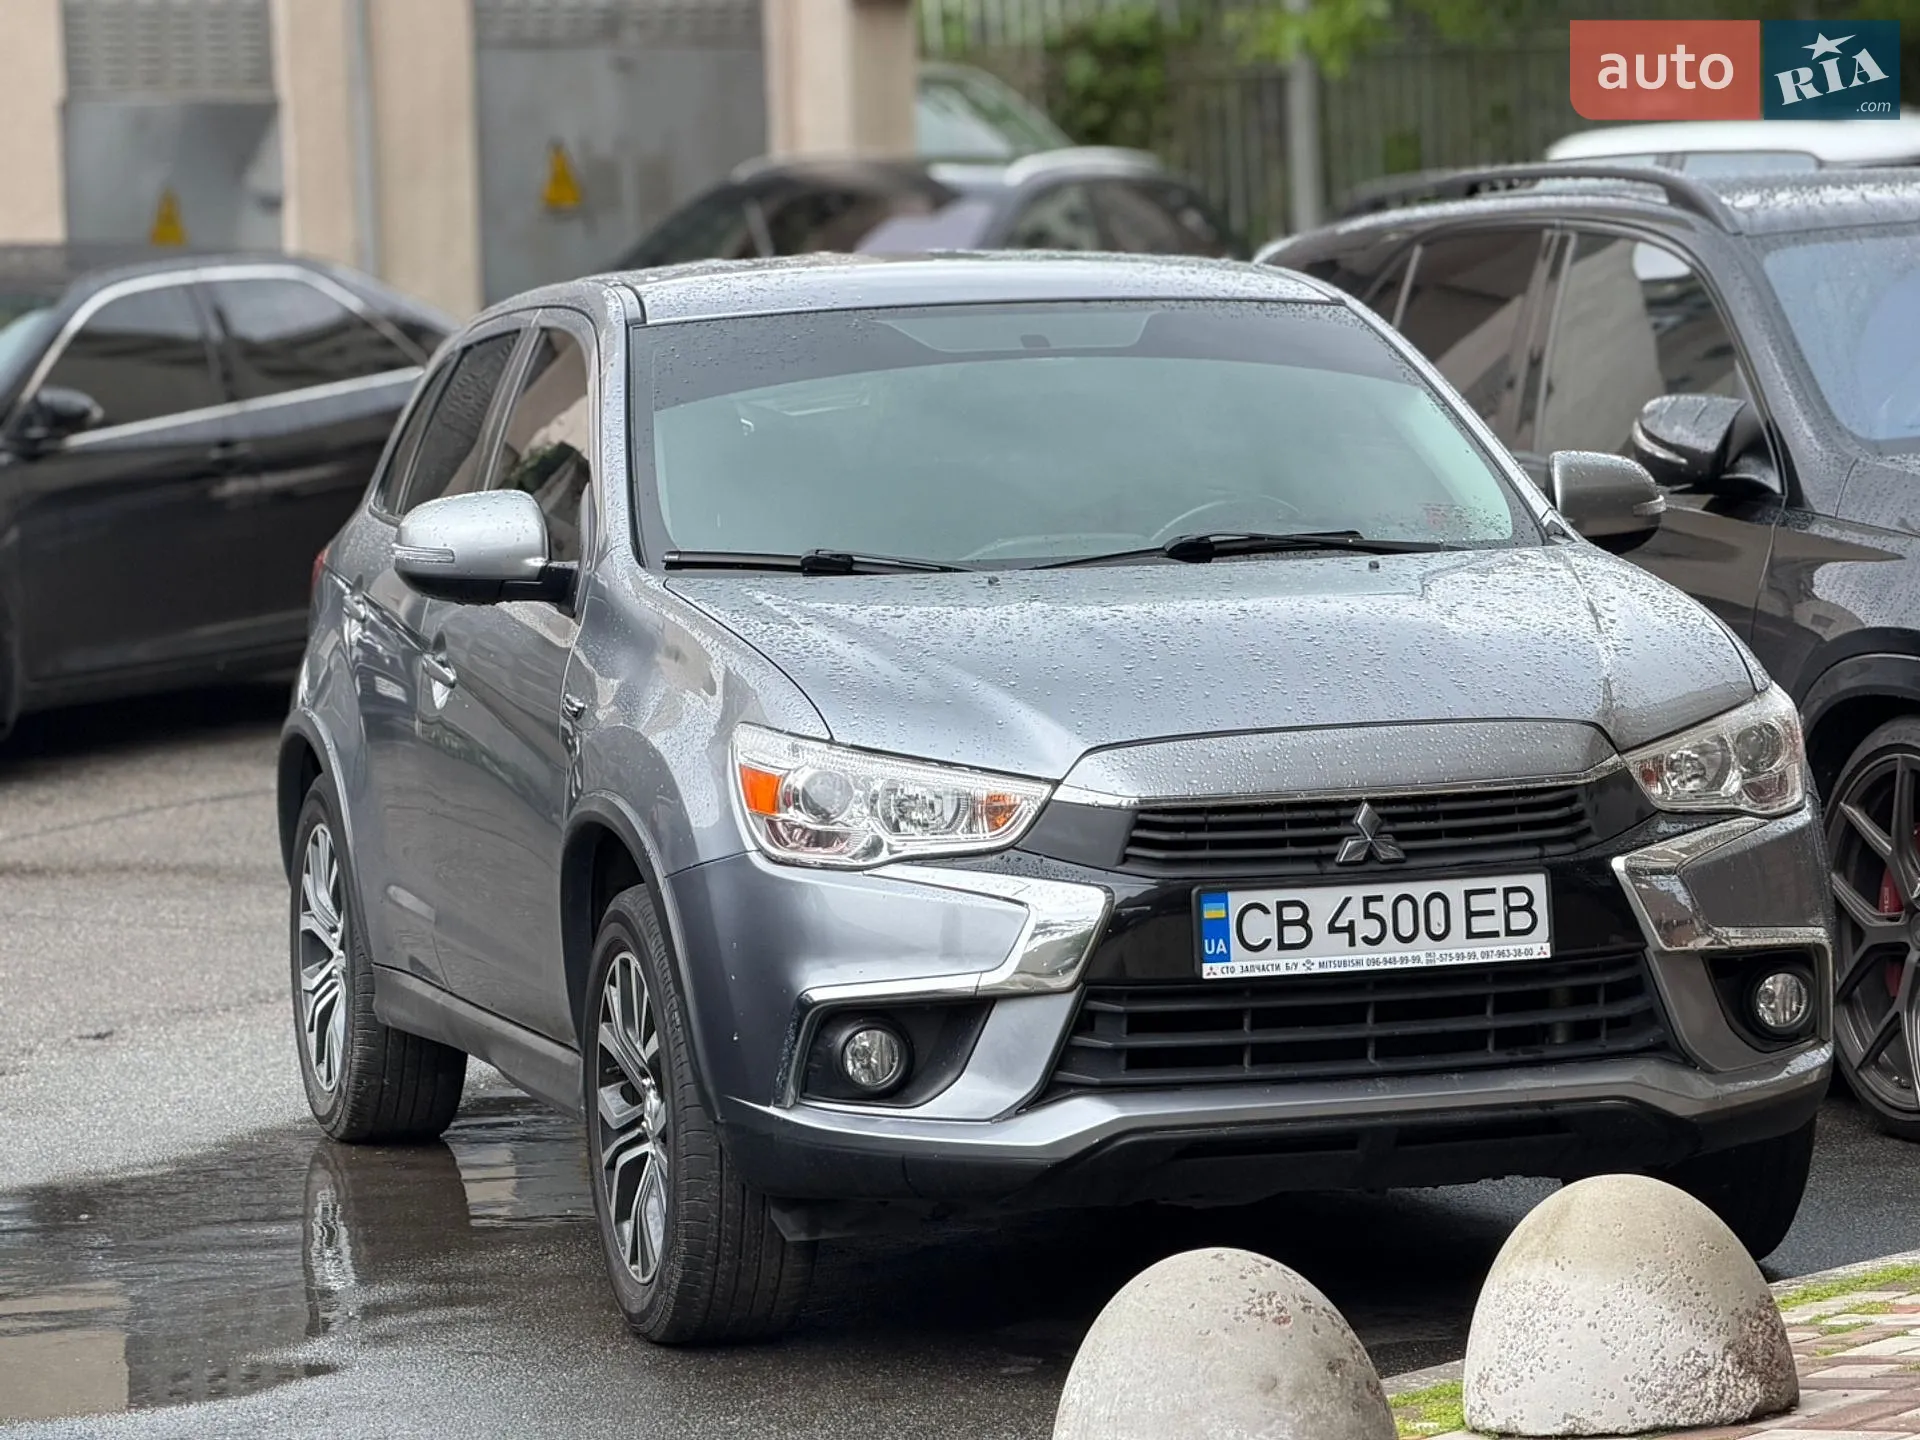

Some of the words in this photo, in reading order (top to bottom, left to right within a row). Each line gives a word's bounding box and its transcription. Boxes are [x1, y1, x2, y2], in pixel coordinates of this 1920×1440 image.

[1235, 899, 1313, 953] CB
[1327, 891, 1450, 948] 4500
[1464, 886, 1538, 940] EB
[1205, 938, 1227, 955] UA
[1240, 963, 1281, 974] ЗАПЧАСТИ
[1318, 958, 1364, 969] MITSUBISHI
